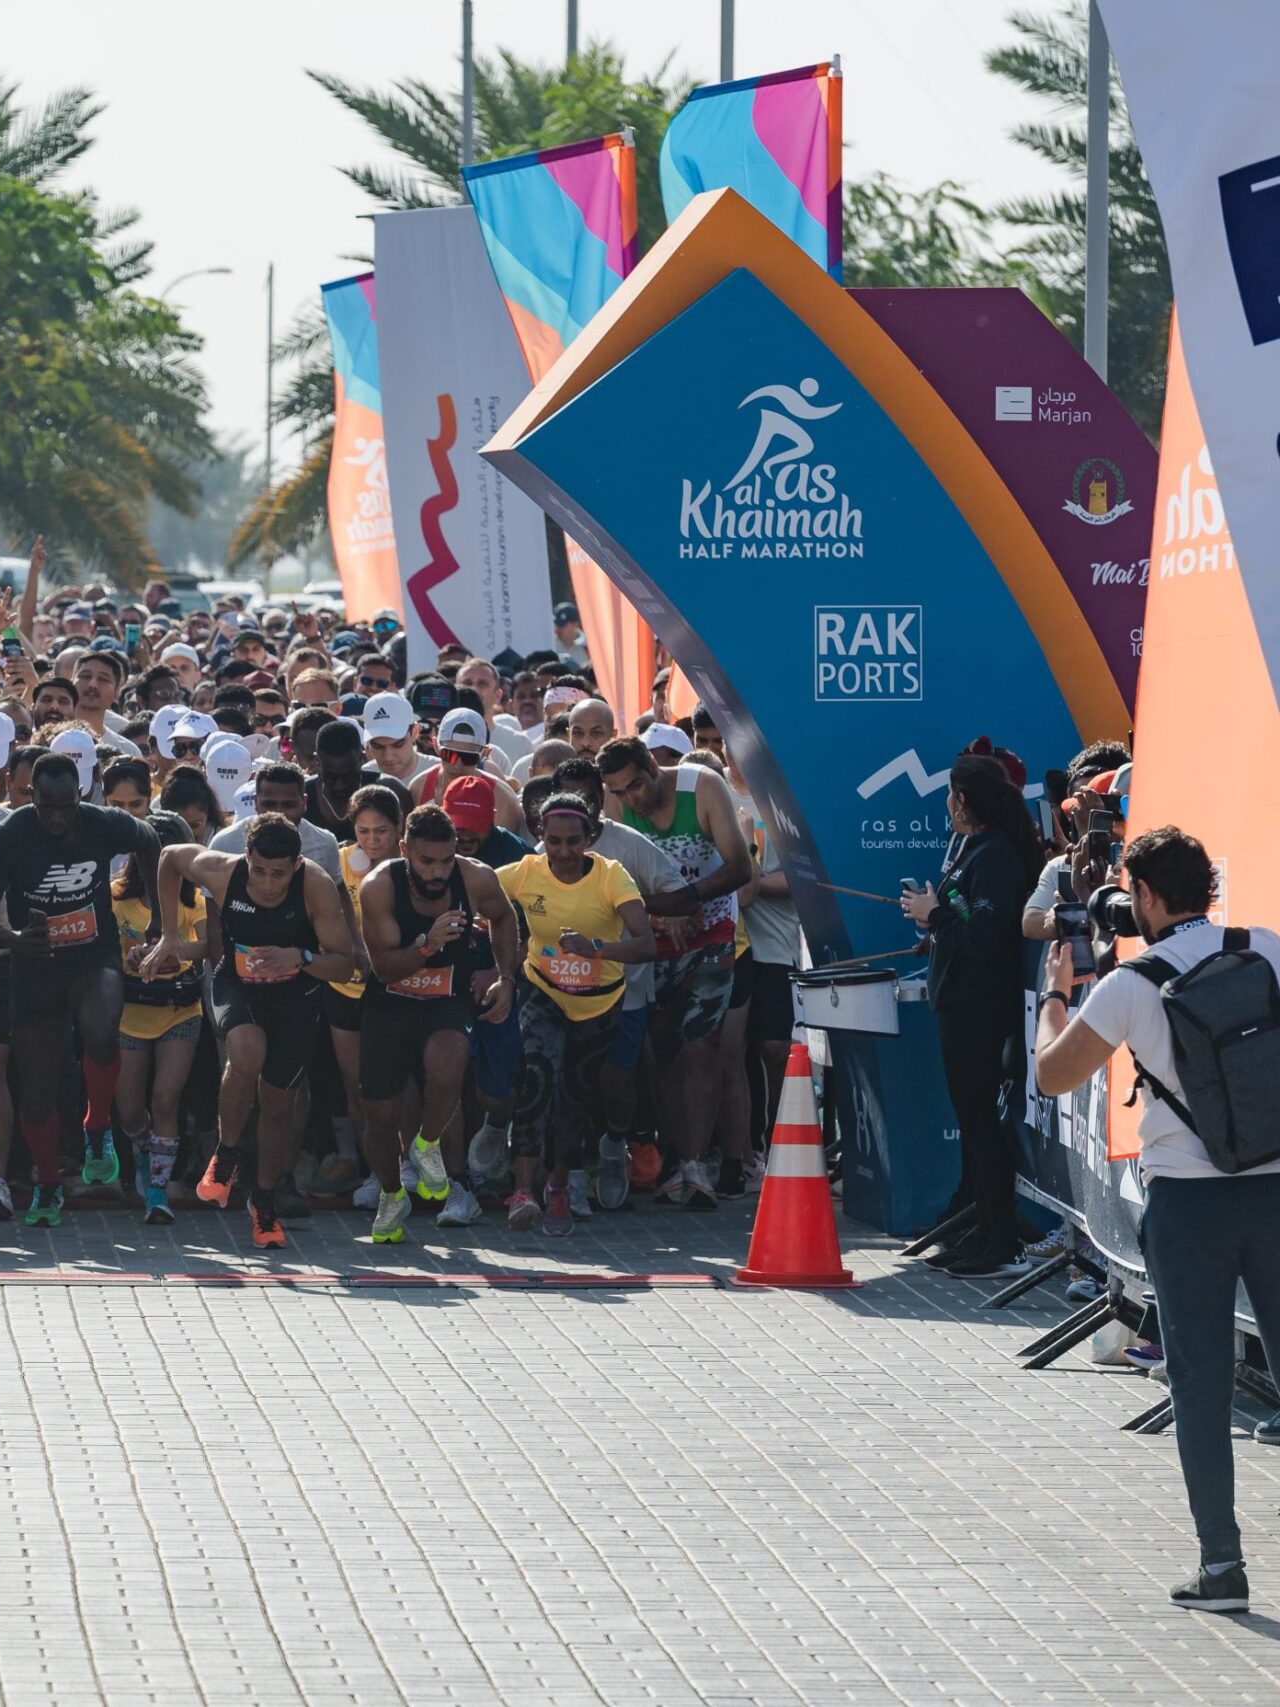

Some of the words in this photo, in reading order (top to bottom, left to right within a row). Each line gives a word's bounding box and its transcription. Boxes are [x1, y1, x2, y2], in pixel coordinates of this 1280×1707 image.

[1038, 387, 1076, 405] مرجان
[1038, 407, 1091, 425] Marjan
[734, 474, 761, 505] al
[680, 479, 864, 539] Khaimah
[680, 543, 734, 559] HALF
[740, 543, 864, 559] MARATHON
[1090, 560, 1136, 586] Mai
[819, 613, 917, 655] RAK
[819, 662, 919, 694] PORTS
[861, 820, 897, 832] ras
[909, 815, 932, 832] al
[861, 837, 904, 849] tourism
[907, 837, 950, 849] develo
[49, 920, 87, 936] 5412
[550, 960, 591, 975] 5260
